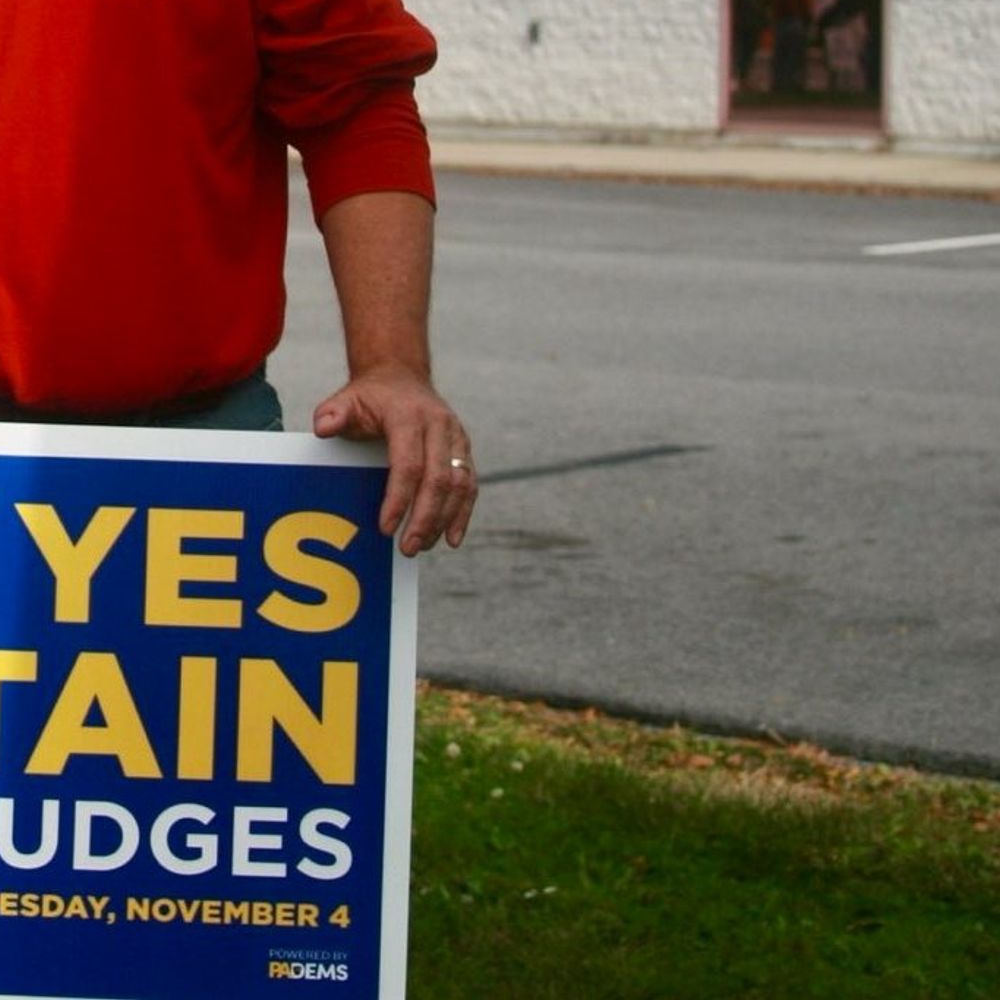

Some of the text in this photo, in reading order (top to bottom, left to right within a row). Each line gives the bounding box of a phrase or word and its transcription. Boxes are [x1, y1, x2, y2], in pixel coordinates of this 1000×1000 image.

[15, 502, 361, 633] YES
[127, 897, 318, 928] NOVEMBER
[329, 905, 351, 928] 4
[268, 949, 348, 961] POWERED BY
[268, 961, 349, 981] PADEMS
